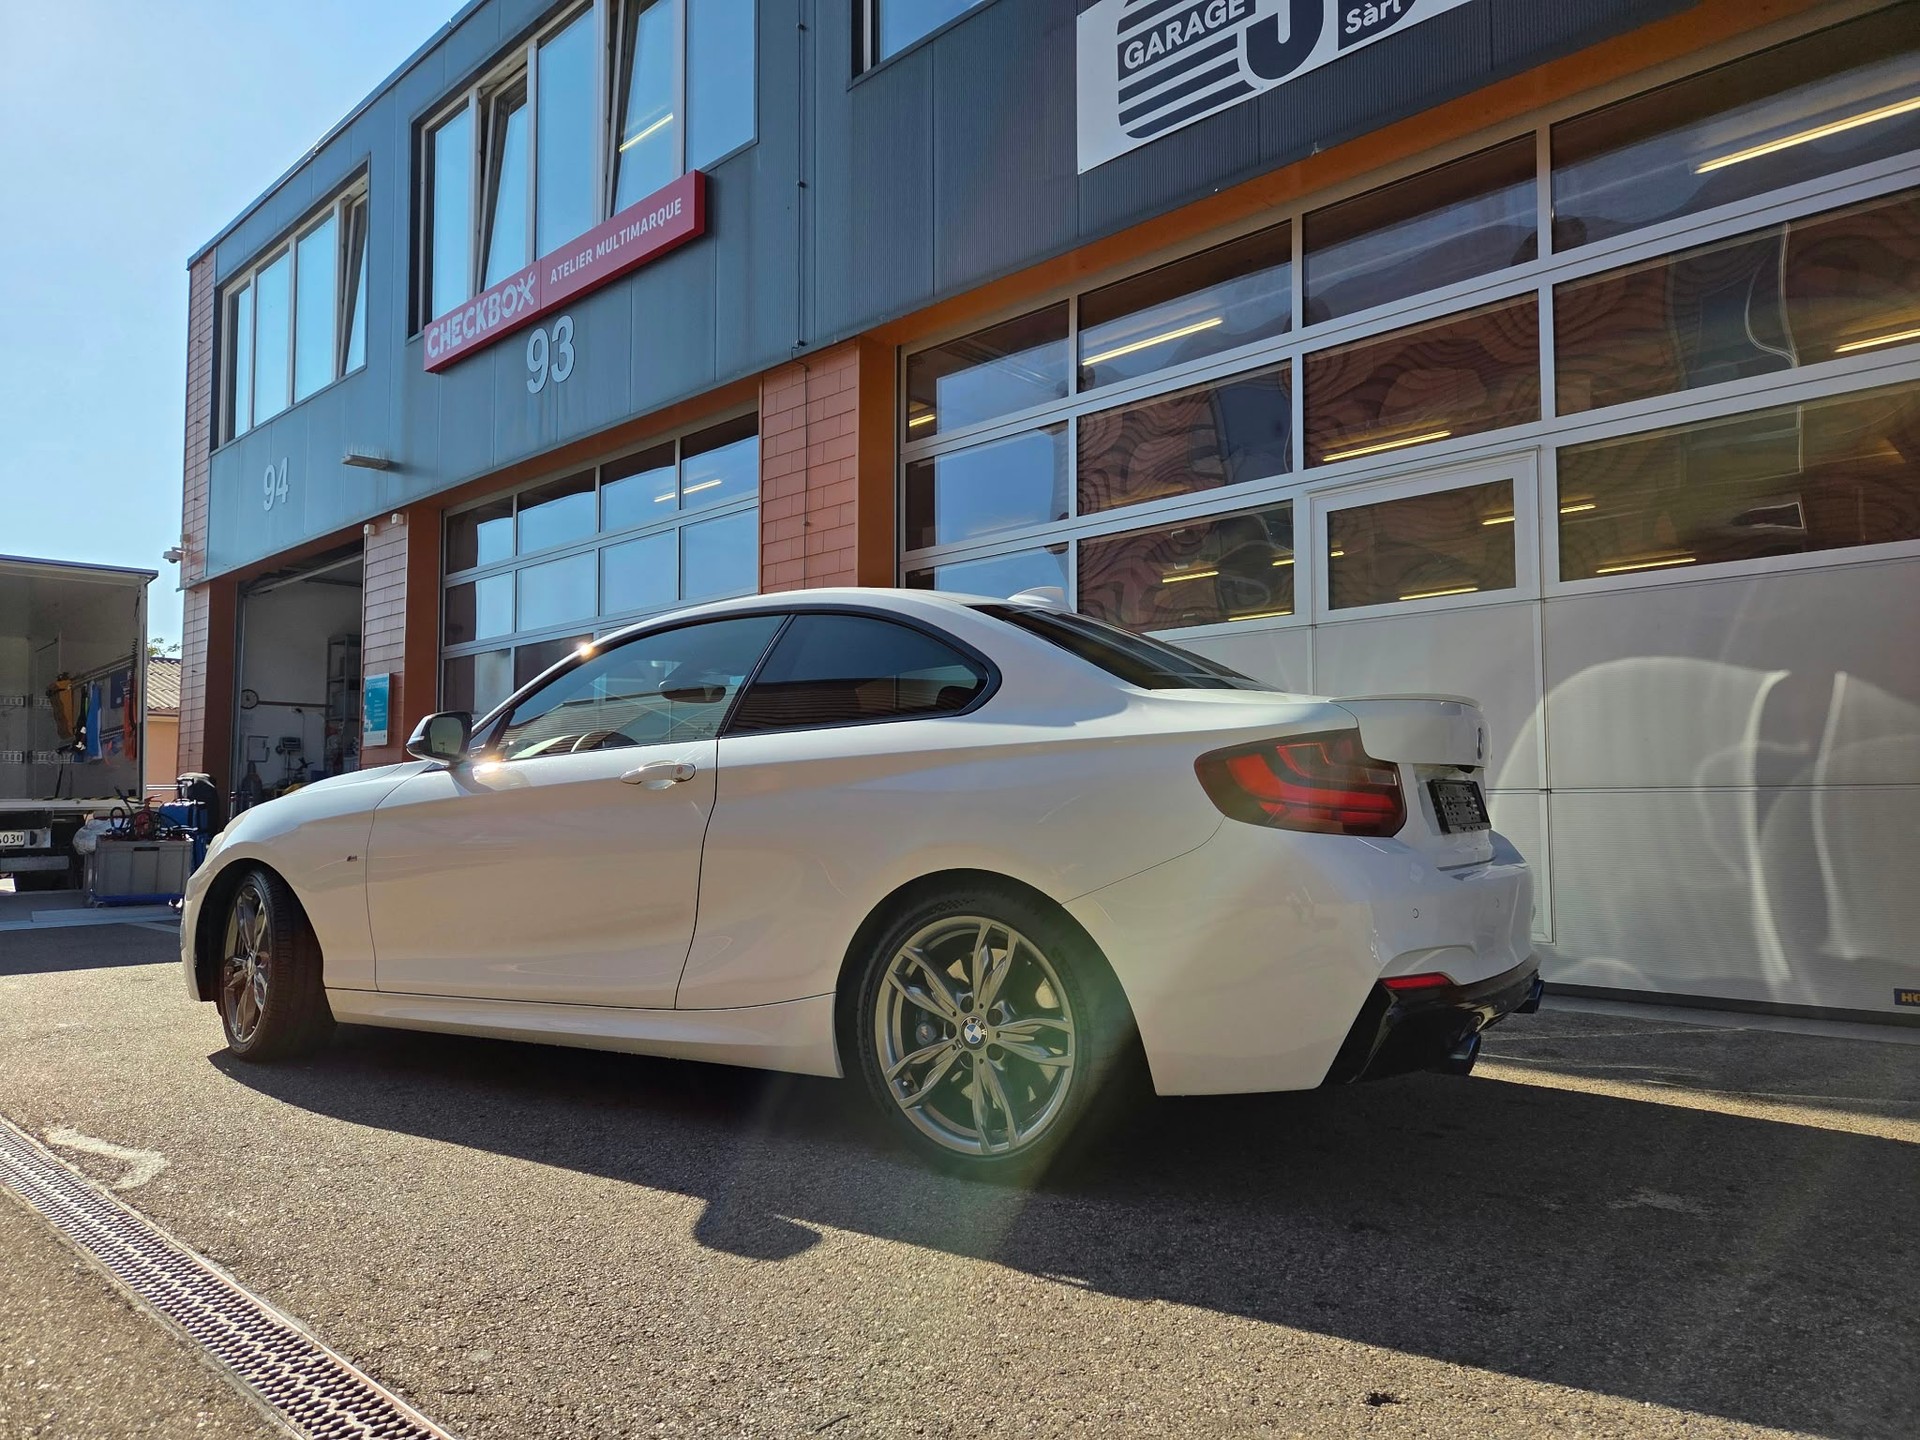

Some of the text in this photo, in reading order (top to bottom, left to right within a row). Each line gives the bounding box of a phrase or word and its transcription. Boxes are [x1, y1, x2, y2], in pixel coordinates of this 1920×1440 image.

[1124, 0, 1245, 69] GARAGE
[550, 198, 682, 284] ATELIER MULTIMARQUE
[427, 271, 536, 358] CHECKBOX
[526, 315, 575, 394] 93
[263, 457, 289, 511] 94
